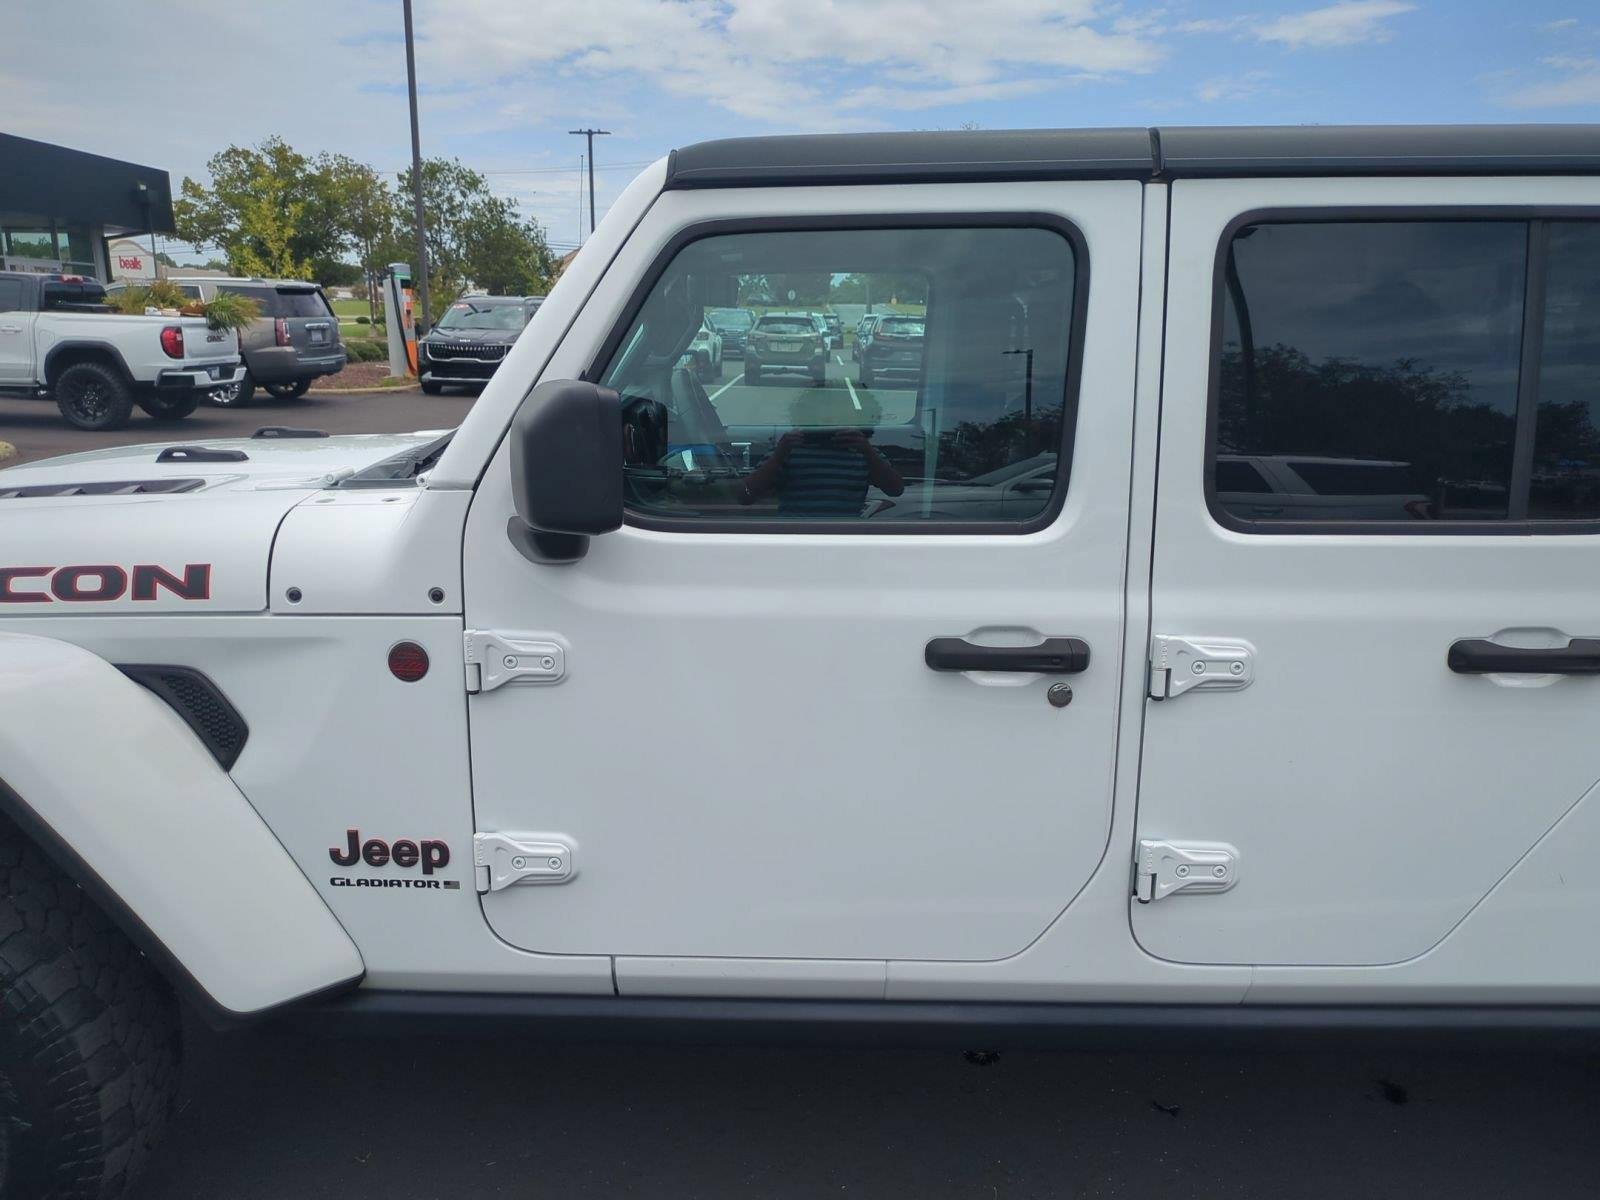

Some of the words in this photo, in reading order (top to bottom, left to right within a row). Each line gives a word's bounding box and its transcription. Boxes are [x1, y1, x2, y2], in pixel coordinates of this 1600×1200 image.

[118, 255, 142, 270] bealls
[328, 829, 450, 875] Jeep
[329, 877, 441, 889] GLADIATOR
